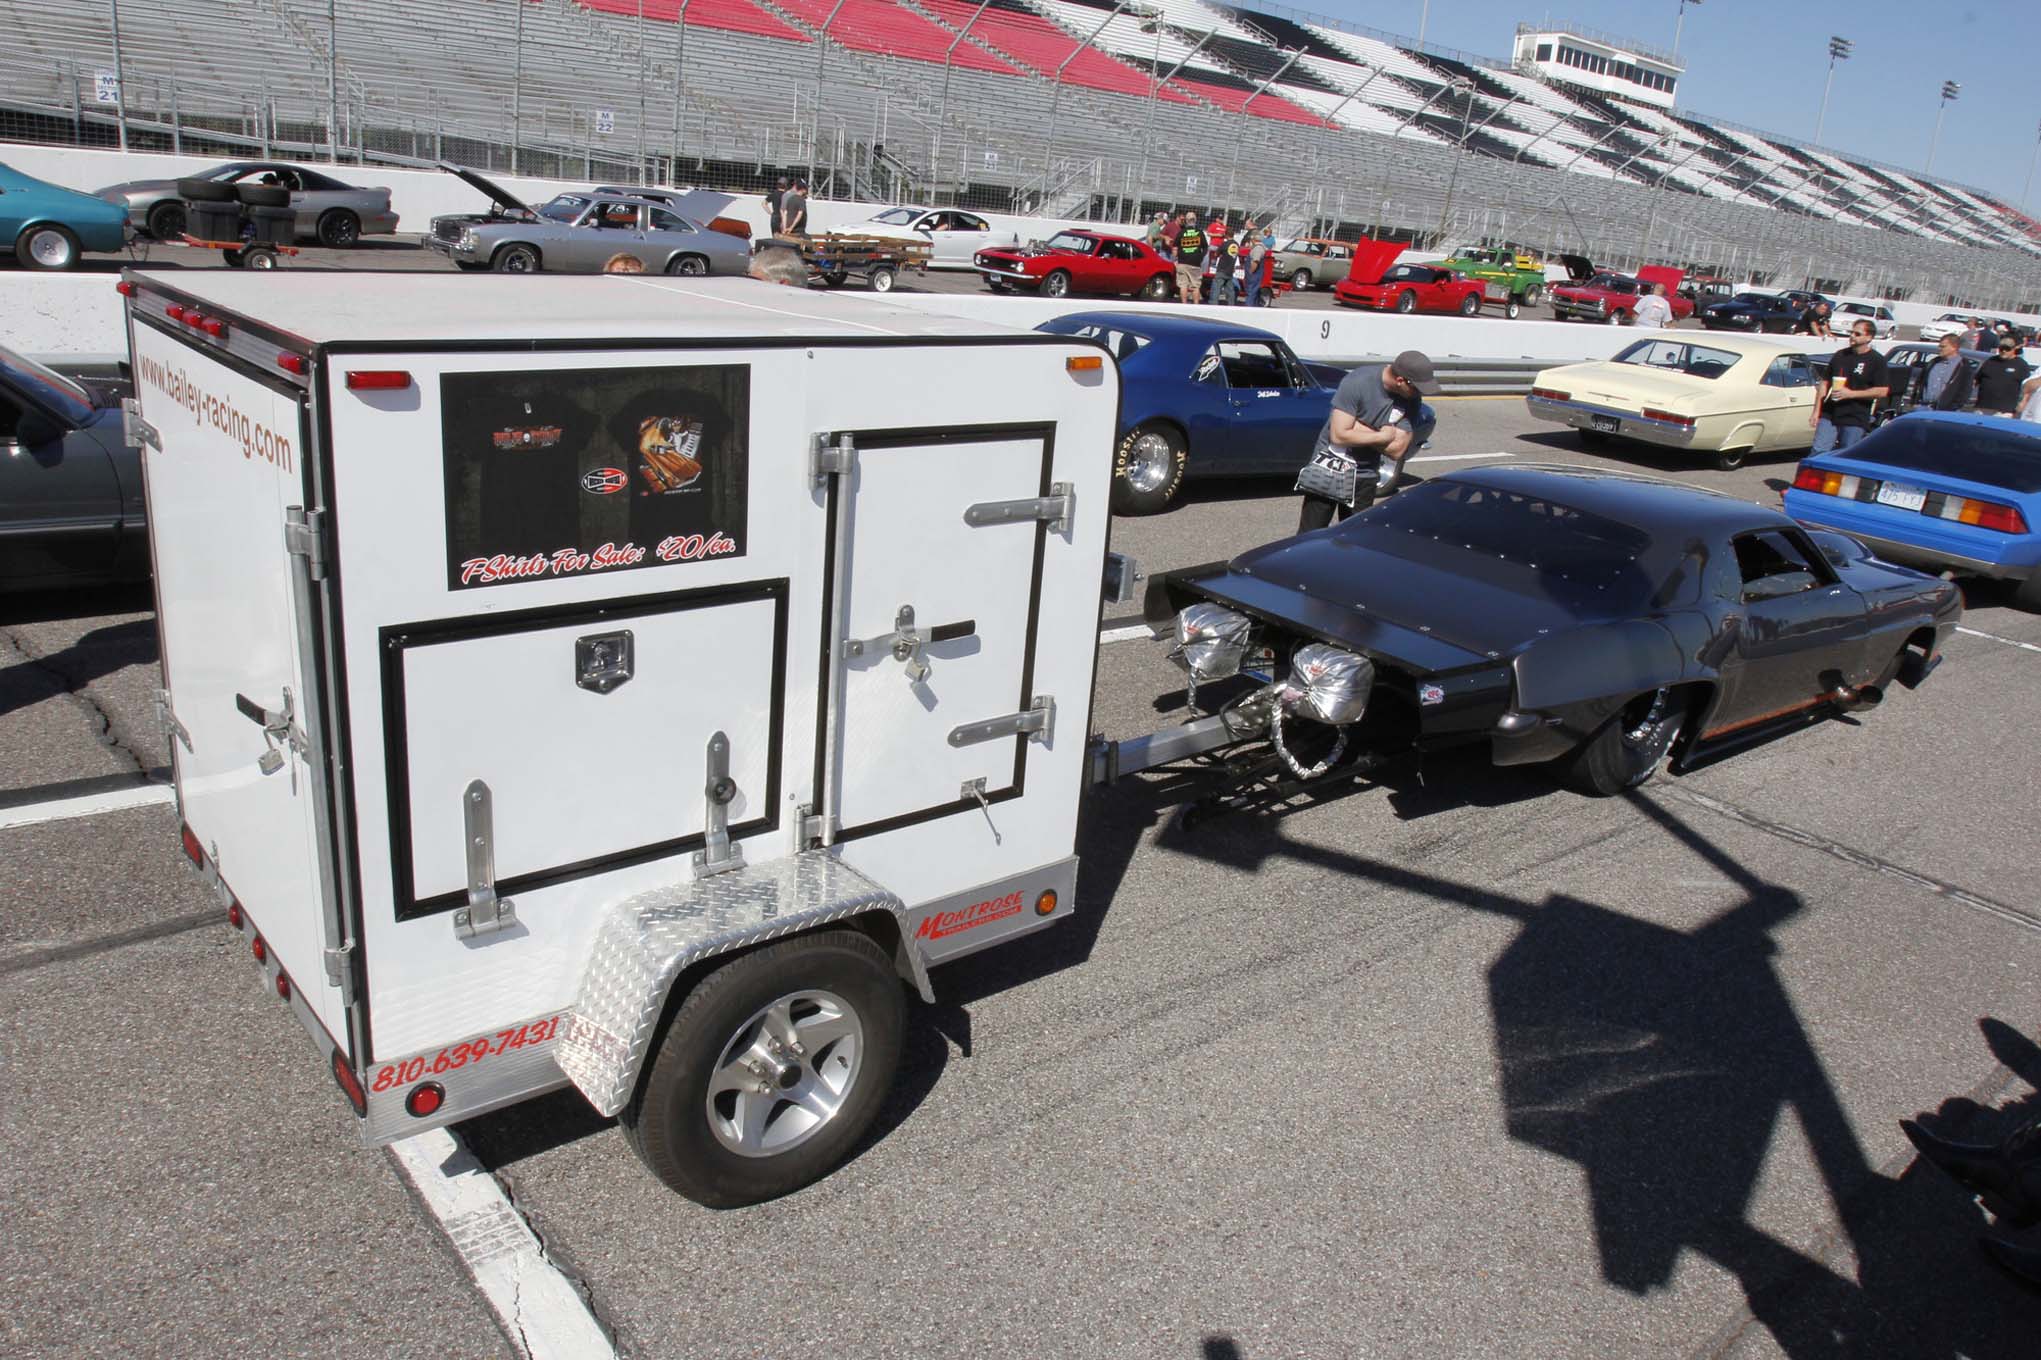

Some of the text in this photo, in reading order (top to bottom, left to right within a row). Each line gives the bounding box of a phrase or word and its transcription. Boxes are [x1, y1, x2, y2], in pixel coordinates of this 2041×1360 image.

[103, 76, 114, 85] M
[99, 90, 118, 101] 21
[1320, 319, 1330, 340] 9
[139, 352, 293, 475] www.bailey-racing.com
[461, 531, 737, 584] T-Shirts For Sale: $20/ea.
